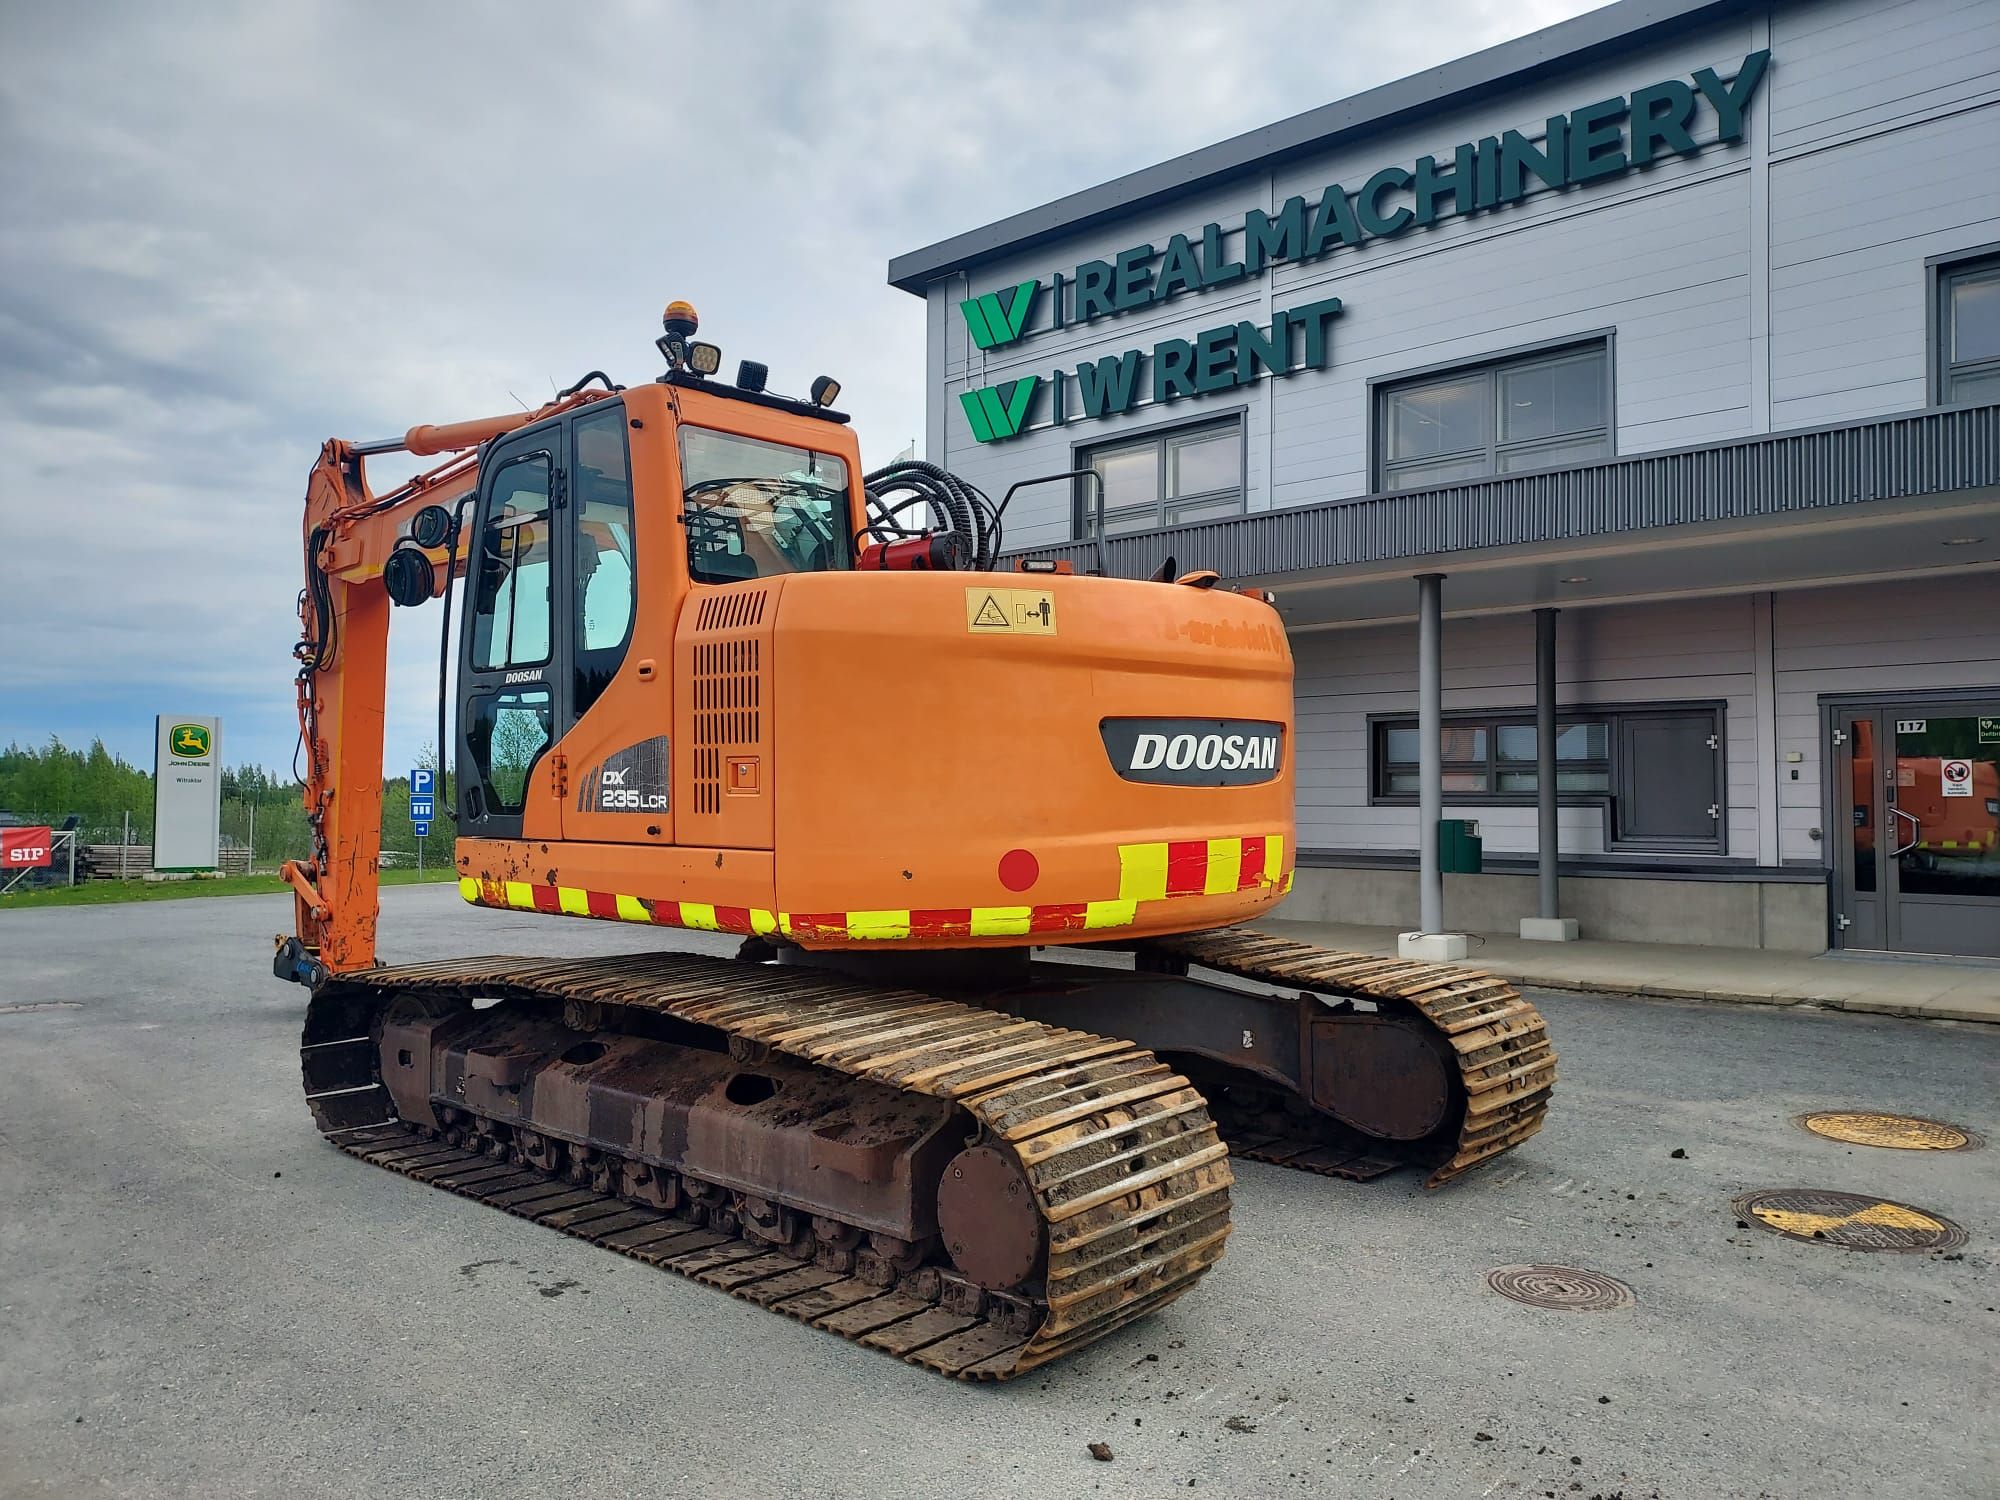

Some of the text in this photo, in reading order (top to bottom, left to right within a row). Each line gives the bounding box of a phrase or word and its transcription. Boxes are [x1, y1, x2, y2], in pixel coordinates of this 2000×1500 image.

[1075, 48, 1772, 321] REALMACHINERY
[1077, 349, 1141, 418] W
[1153, 297, 1343, 402] RENT
[505, 669, 542, 684] DOOSAN
[1899, 722, 1924, 732] 117
[1129, 734, 1277, 770] DOOSAN
[415, 771, 431, 792] P
[602, 767, 631, 785] DX
